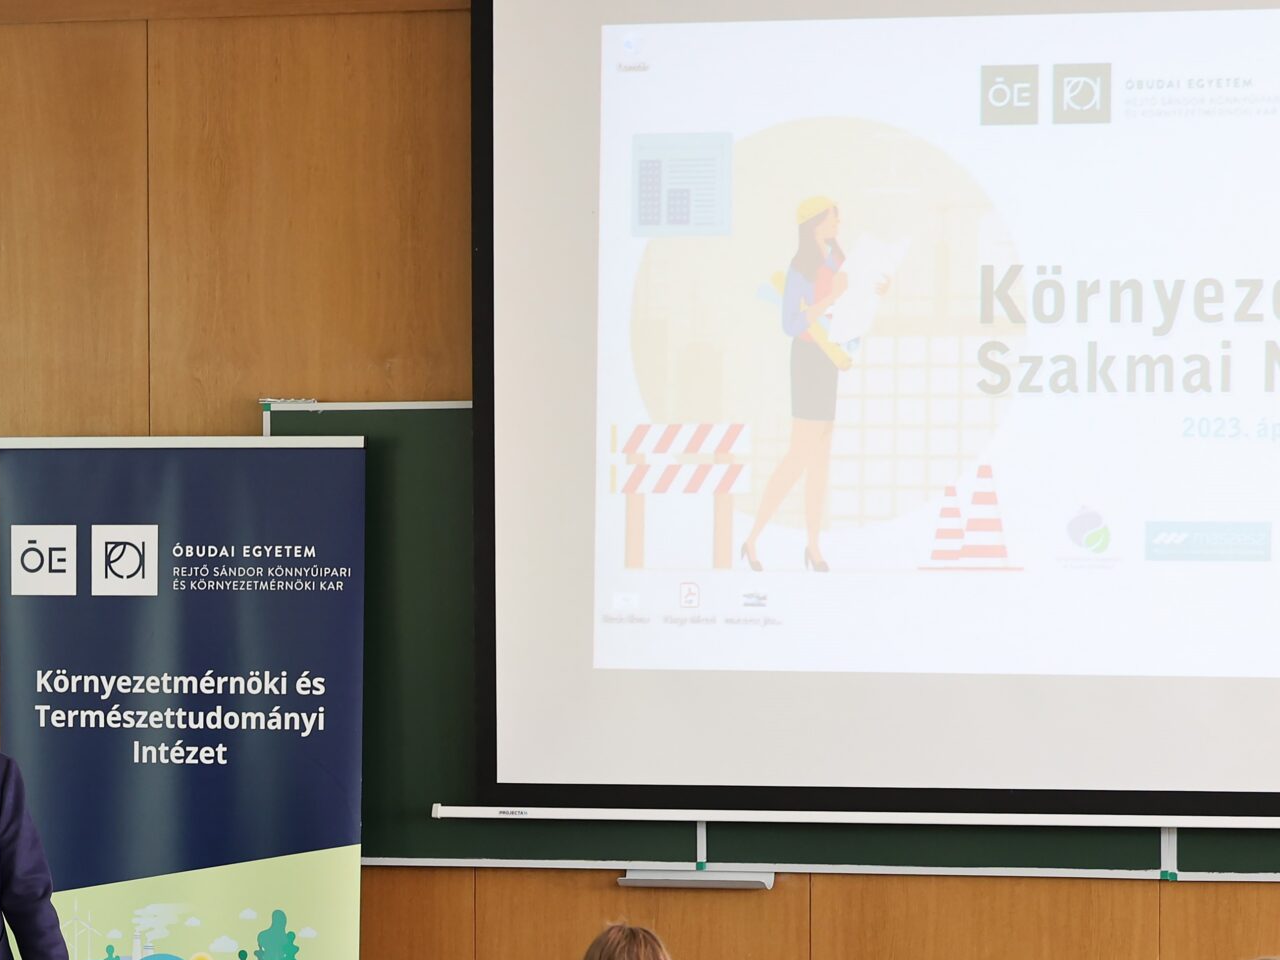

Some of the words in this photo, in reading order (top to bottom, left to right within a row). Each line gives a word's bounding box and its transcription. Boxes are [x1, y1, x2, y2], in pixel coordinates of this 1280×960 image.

[1186, 77, 1253, 90] EGYETEM
[979, 264, 1280, 337] Környez
[976, 340, 1232, 395] Szakmai
[1182, 416, 1249, 439] 2023.
[172, 542, 235, 558] ÓBUDAI
[243, 545, 316, 558] EGYETEM
[172, 564, 209, 577] REJTŐ
[213, 564, 263, 577] SÁNDOR
[267, 564, 351, 578] KÖNNYŰIPARI
[172, 578, 186, 591] ÉS
[190, 578, 316, 591] KÖRNYEZETMÉRNÖKI
[320, 580, 344, 591] KAR
[36, 669, 287, 700] Környezetmérnöki
[295, 670, 326, 696] és
[34, 704, 325, 737] Természettudományi
[133, 740, 227, 765] Intézet
